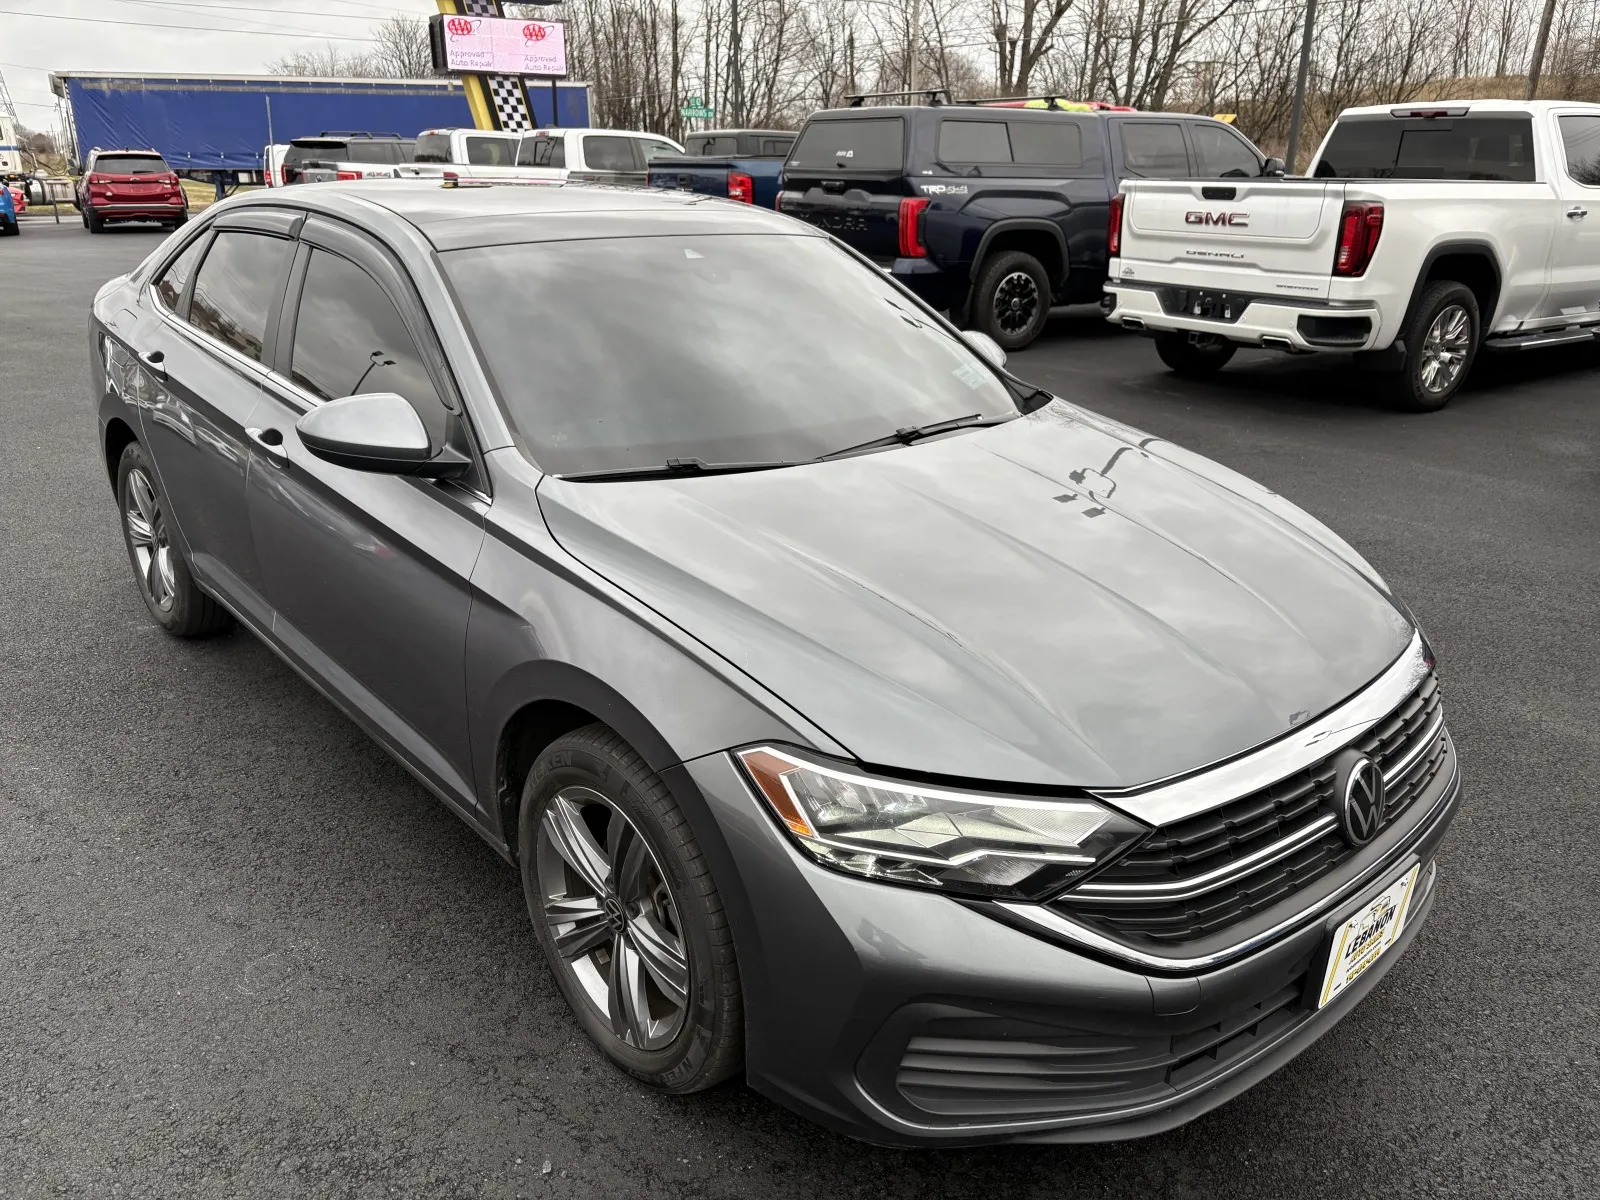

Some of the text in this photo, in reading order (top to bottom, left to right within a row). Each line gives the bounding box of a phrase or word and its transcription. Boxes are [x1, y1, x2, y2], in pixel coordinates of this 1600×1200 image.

[448, 19, 472, 35] AAA
[524, 25, 546, 41] AAA
[450, 50, 485, 59] Approved
[524, 55, 557, 63] Approved
[450, 59, 493, 69] Auto Repair
[543, 64, 564, 72] Repair
[920, 185, 946, 195] TRD
[1185, 210, 1250, 227] GMC
[1186, 249, 1245, 259] DENALI
[1345, 905, 1397, 959] LEBANON
